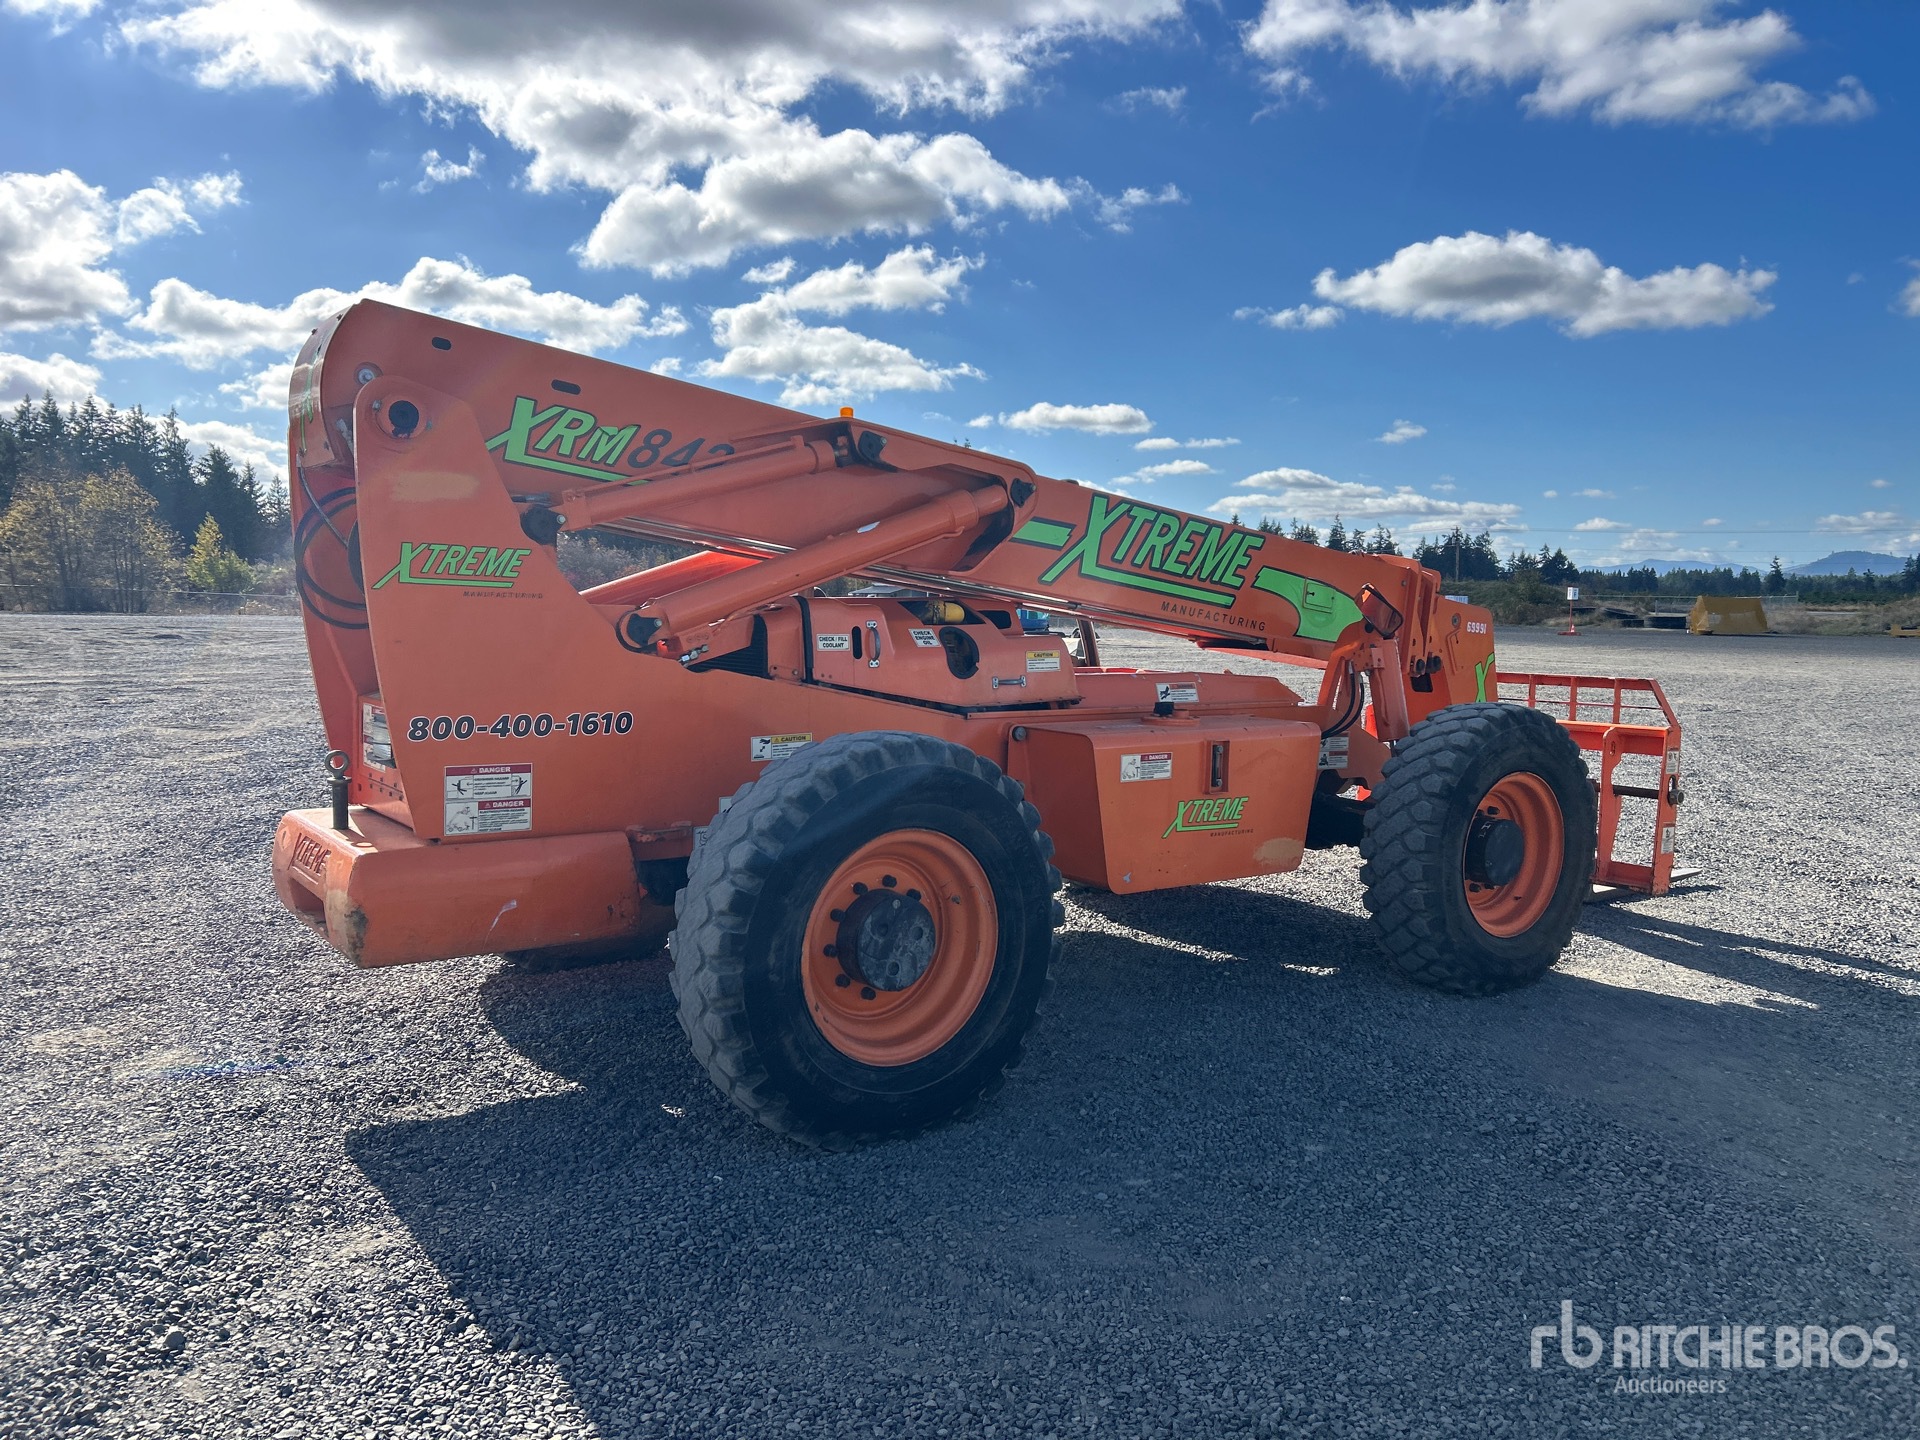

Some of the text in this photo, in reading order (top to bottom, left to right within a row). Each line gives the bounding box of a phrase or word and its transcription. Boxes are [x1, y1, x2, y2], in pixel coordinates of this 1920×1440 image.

[371, 541, 532, 589] XTREME
[1039, 493, 1265, 607] XTREME
[1160, 601, 1267, 632] MANUFACTURING
[407, 711, 634, 742] 800-400-1610
[478, 766, 511, 774] DANGER
[492, 800, 525, 808] DANGER
[1161, 796, 1249, 839] XTREME
[287, 832, 332, 883] XTREME
